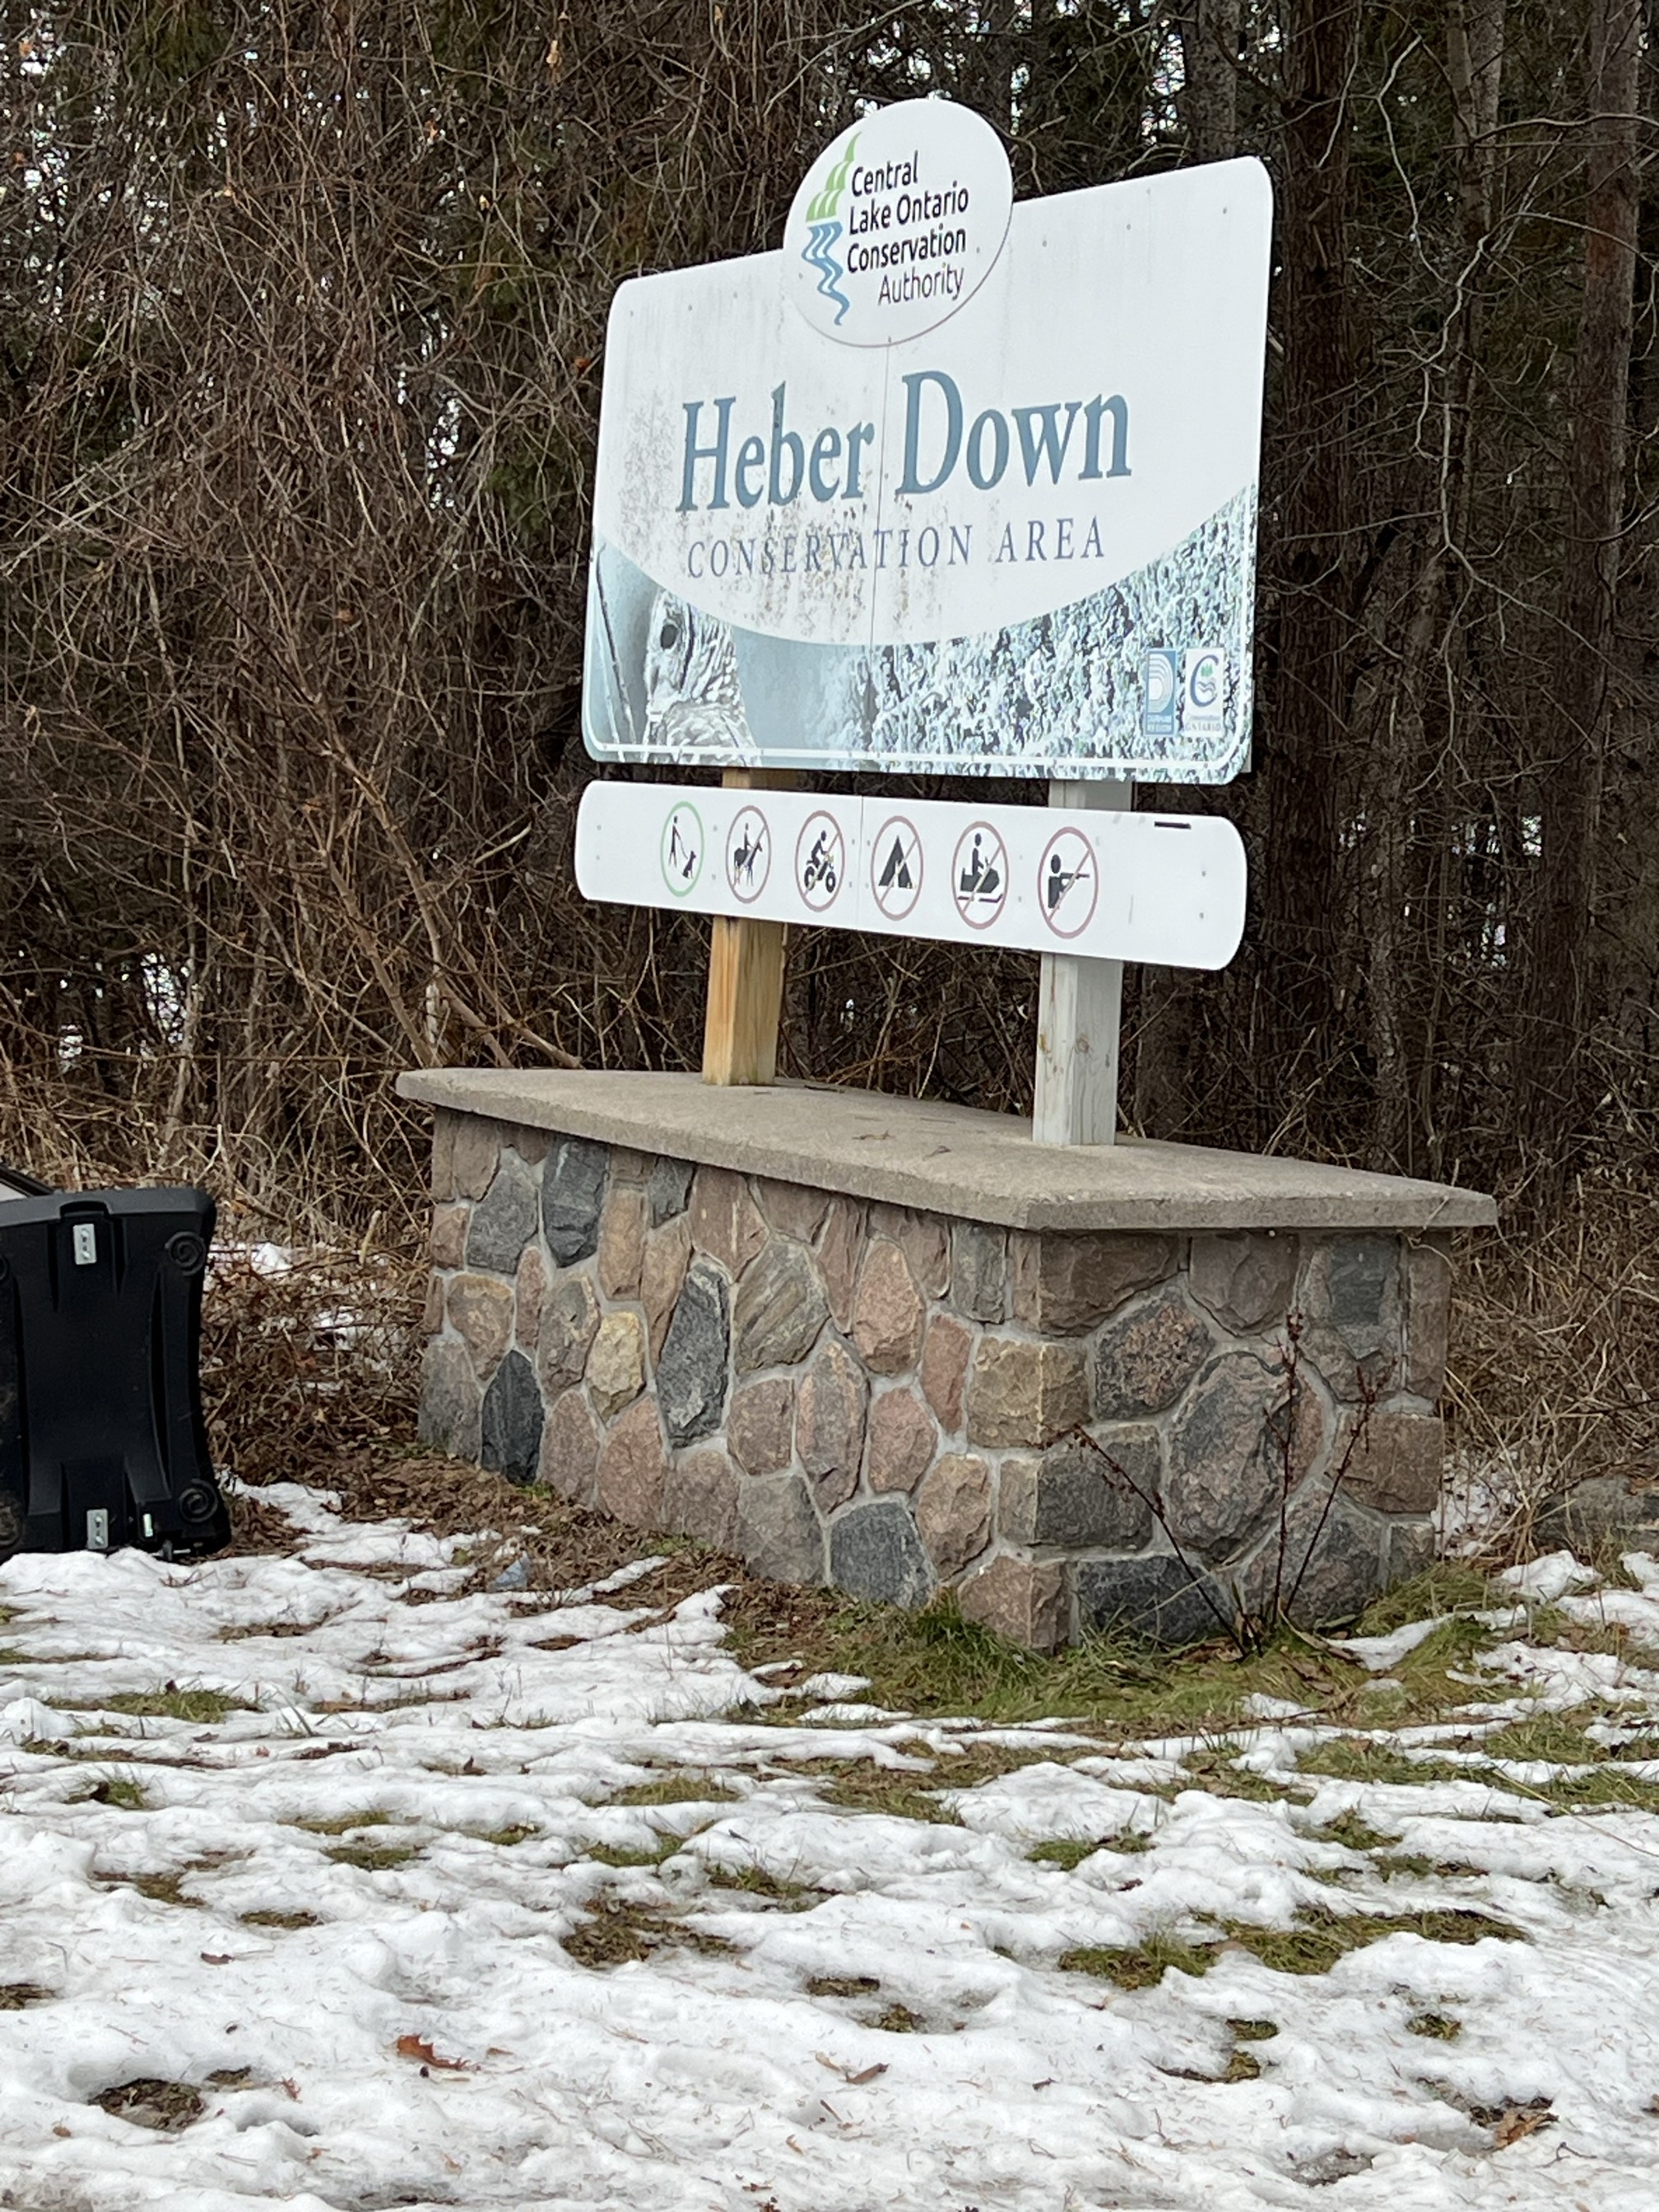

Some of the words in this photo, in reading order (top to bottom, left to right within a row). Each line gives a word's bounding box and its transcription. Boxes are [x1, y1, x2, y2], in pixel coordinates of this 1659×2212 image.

[851, 150, 918, 197] Central
[848, 199, 891, 235] Lake
[896, 180, 969, 225] Ontario
[847, 223, 966, 273] Conservation
[878, 263, 964, 305] Authority
[675, 380, 875, 513] Heber
[895, 370, 1132, 495] Down
[687, 524, 973, 579] CONSERVATION
[995, 515, 1104, 562] AREA
